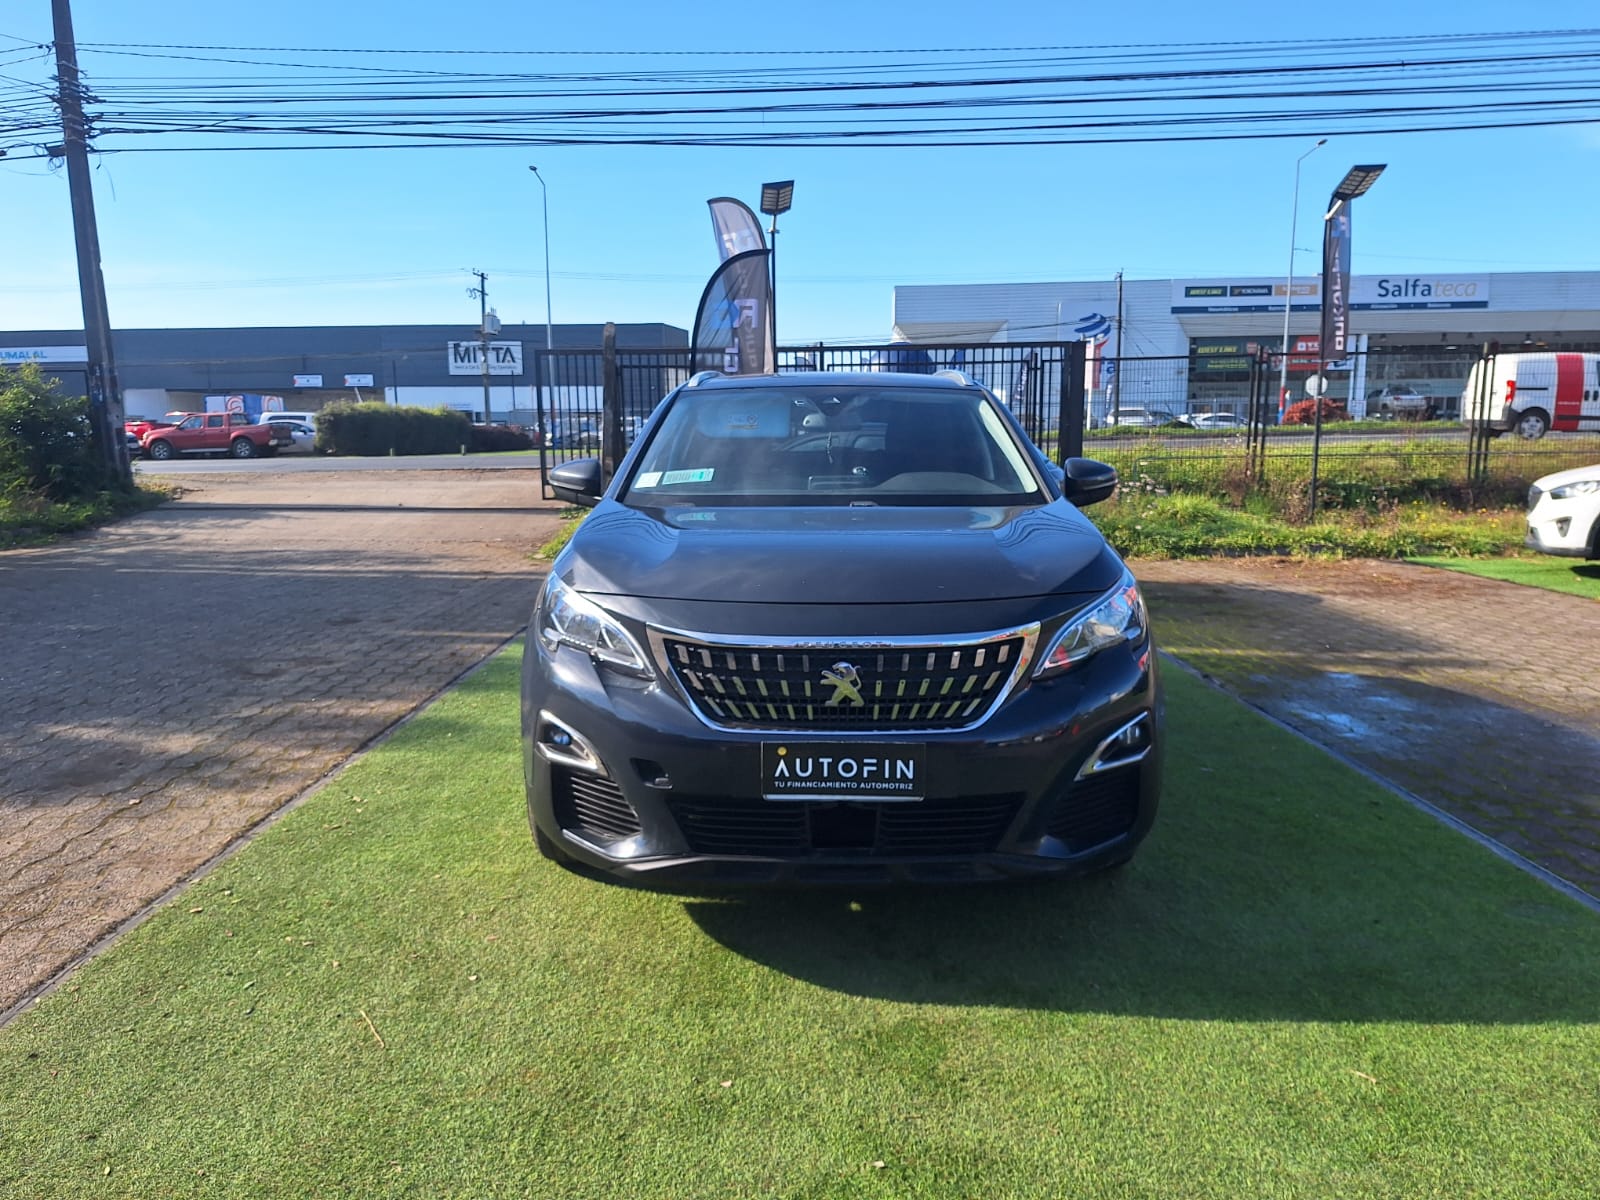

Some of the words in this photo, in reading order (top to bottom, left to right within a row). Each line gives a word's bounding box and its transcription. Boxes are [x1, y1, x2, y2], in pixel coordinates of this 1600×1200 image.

[453, 343, 516, 363] MITTA
[774, 757, 914, 779] AUTOFIN
[787, 781, 857, 789] FINANCIAMIENTO
[859, 782, 913, 790] AUTOMOTRIZ
